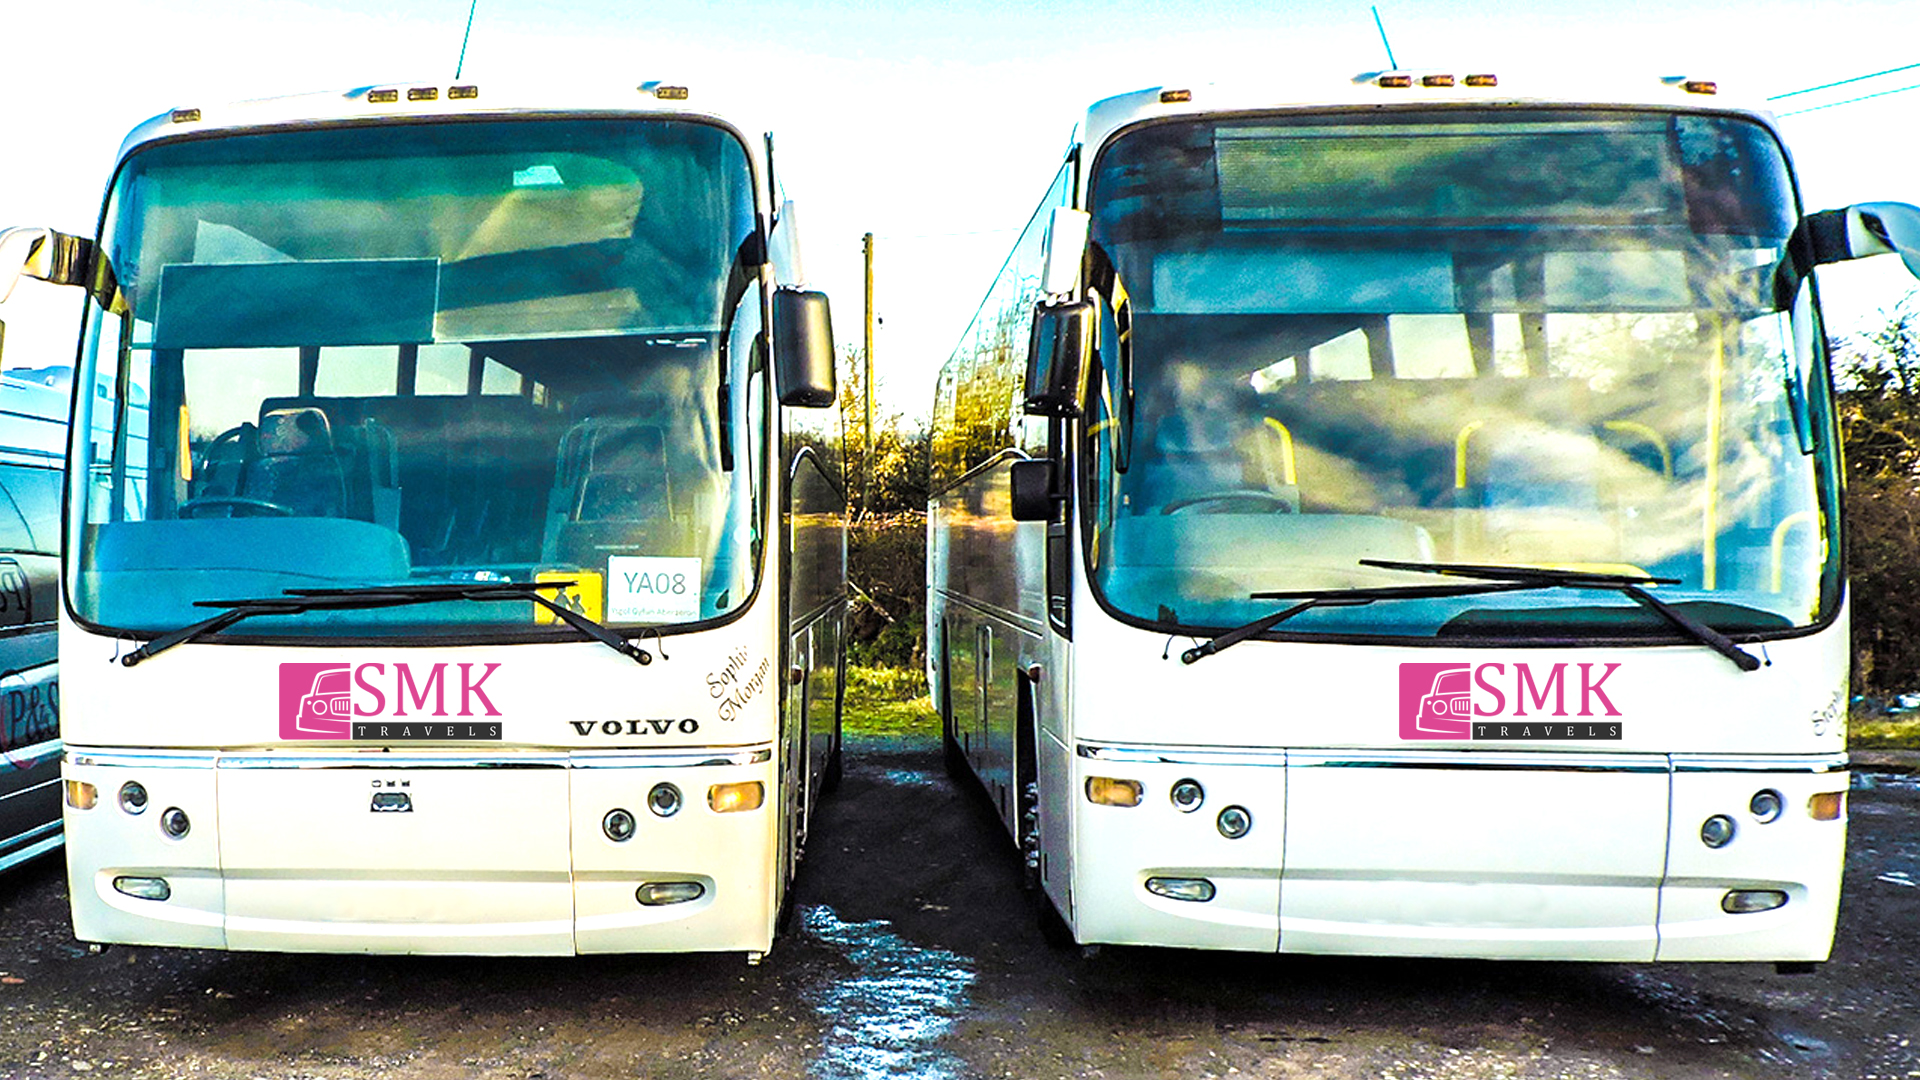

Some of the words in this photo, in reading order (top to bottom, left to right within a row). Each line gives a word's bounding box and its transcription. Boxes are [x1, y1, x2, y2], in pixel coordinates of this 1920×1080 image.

[623, 571, 687, 596] YA08
[353, 662, 503, 717] SMK
[717, 656, 770, 722] Morgan
[1473, 662, 1623, 717] SMK
[357, 725, 498, 737] TRAVELS
[568, 718, 700, 737] VOLVO
[1477, 725, 1618, 737] TRAVELS
